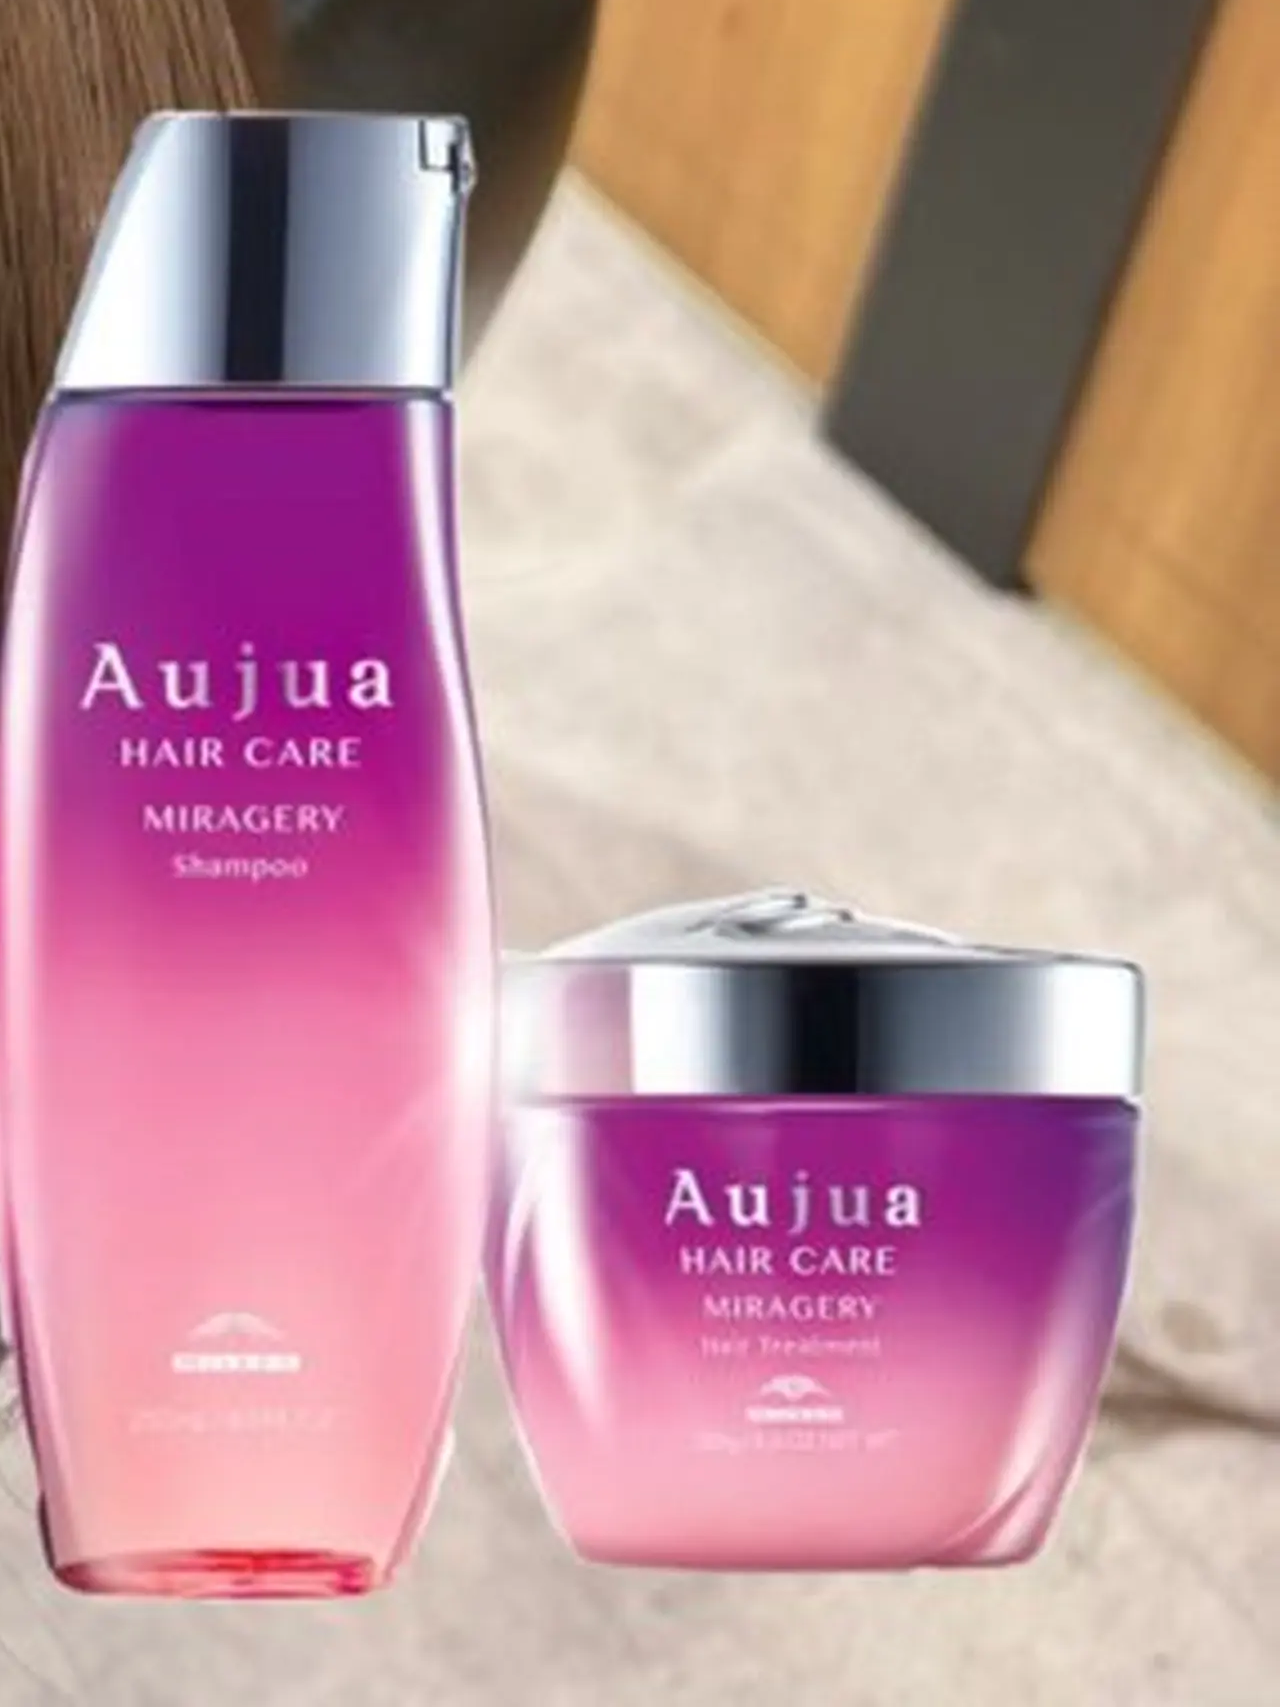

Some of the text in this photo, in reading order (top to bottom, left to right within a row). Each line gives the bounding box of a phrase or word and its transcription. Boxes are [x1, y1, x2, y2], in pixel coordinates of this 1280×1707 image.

[80, 641, 393, 721] Aujua
[120, 738, 362, 768] HAIR CARE
[143, 805, 345, 834] MIRAGERY
[172, 854, 308, 883] Shampoo
[664, 1169, 922, 1235] Aujua
[680, 1246, 897, 1276] HAIR CARE
[702, 1295, 878, 1320] MIRAGERY
